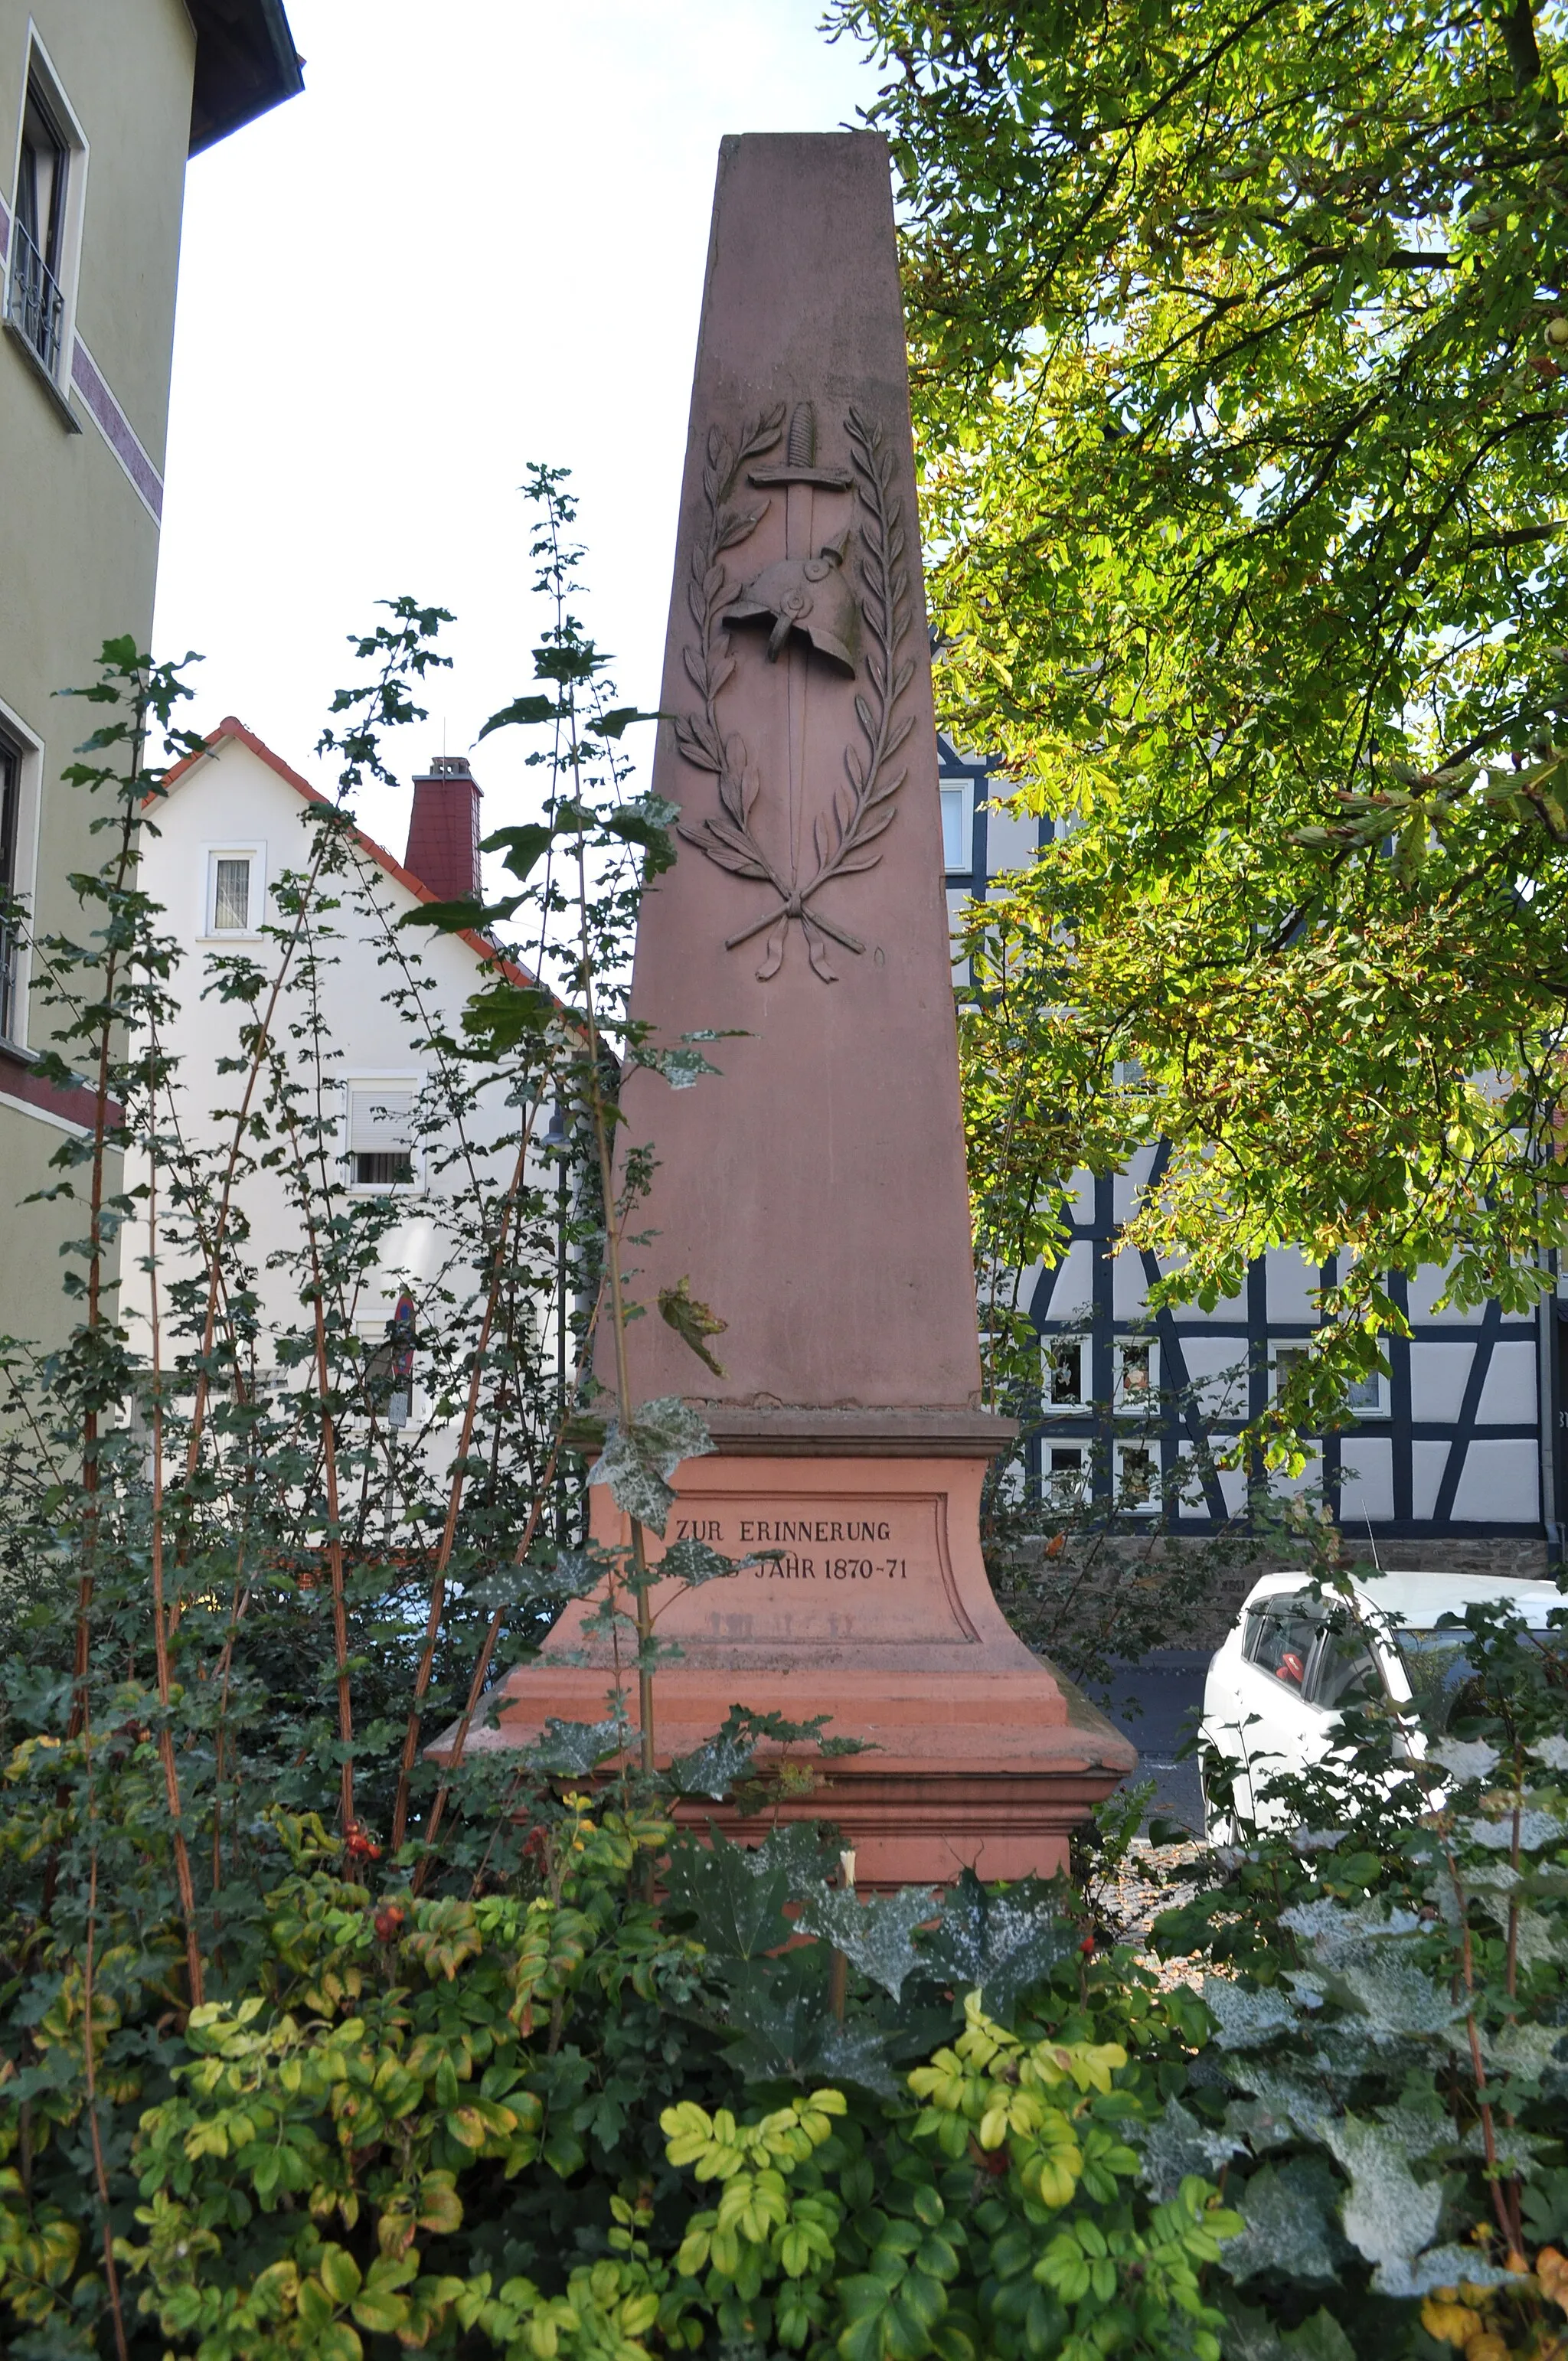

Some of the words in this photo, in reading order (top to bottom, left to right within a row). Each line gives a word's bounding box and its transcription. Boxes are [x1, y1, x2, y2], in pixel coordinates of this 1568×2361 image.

[676, 1520, 724, 1541] ZUR
[740, 1521, 890, 1542] ERINNERUNG
[825, 1558, 906, 1579] 1870-71
